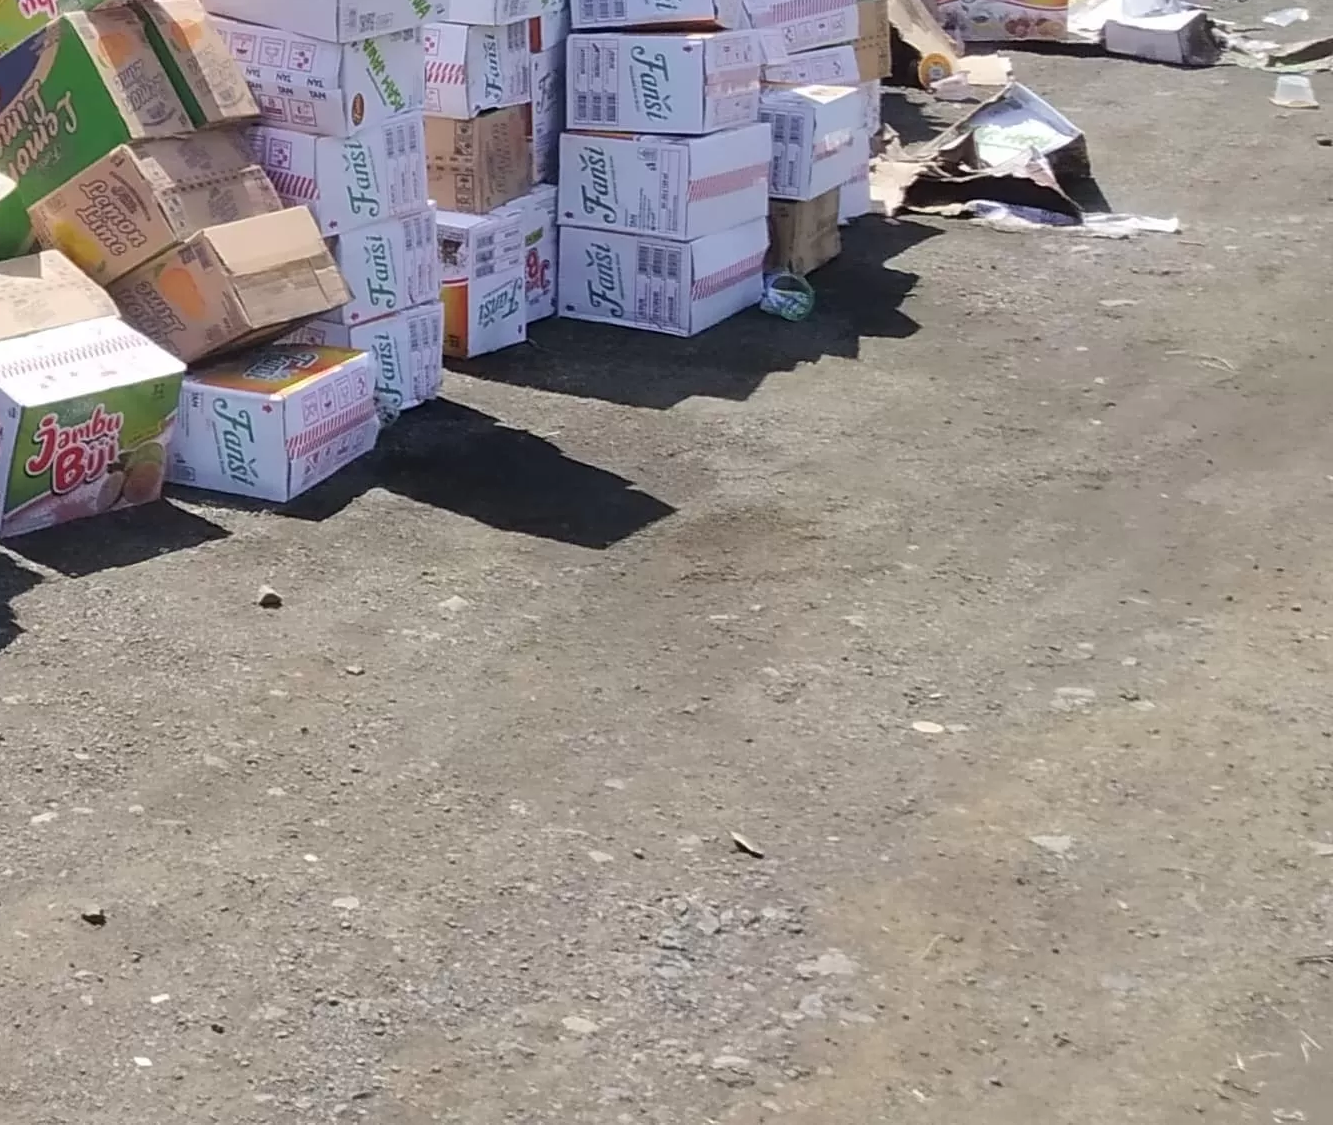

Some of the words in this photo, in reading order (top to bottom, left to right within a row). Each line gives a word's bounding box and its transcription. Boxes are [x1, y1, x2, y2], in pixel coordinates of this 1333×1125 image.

[75, 207, 127, 257] Lime
[80, 179, 148, 248] Lemon
[51, 434, 117, 494] Biji
